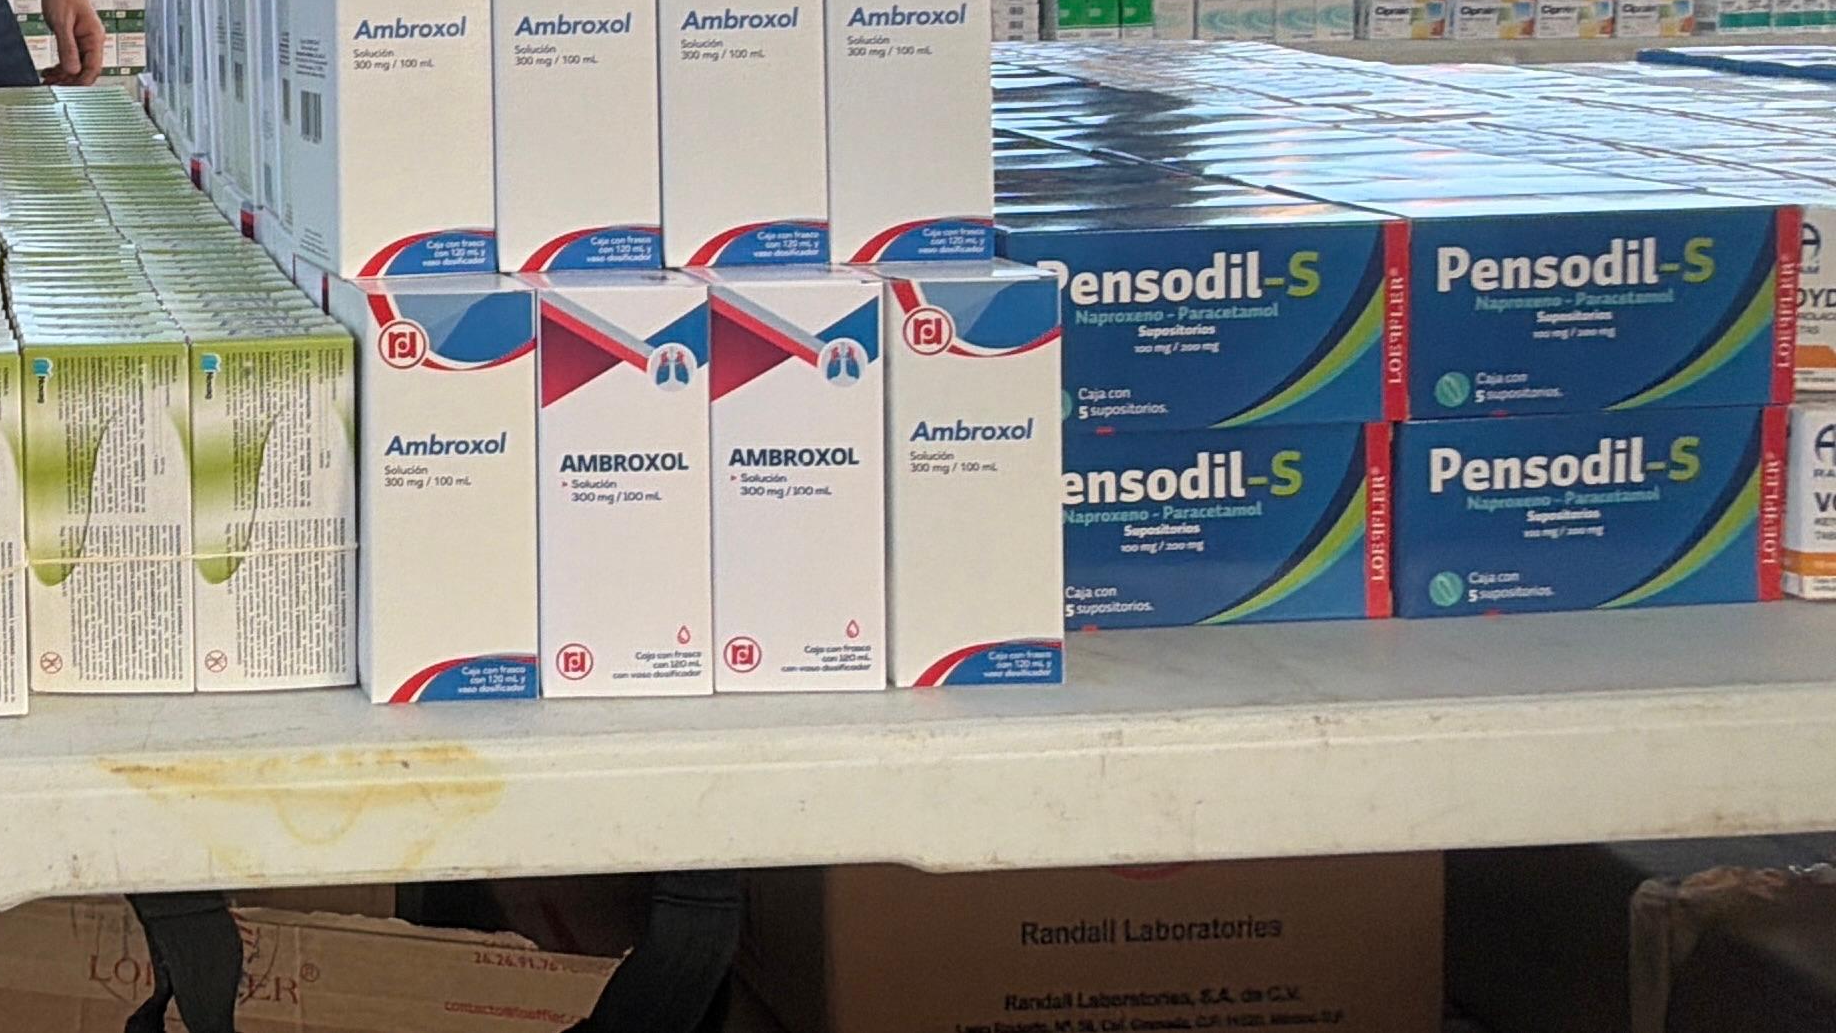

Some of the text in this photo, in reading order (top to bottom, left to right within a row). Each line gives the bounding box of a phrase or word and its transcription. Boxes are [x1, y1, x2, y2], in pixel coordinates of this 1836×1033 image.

[680, 6, 799, 31] Ambroxol
[847, 3, 967, 28] Ambroxol
[353, 15, 466, 40] Ambroxol
[514, 12, 631, 37] Ambroxol
[680, 38, 723, 49] Solución
[847, 35, 890, 45] Solución
[353, 48, 394, 58] Solución
[514, 44, 557, 55] Solución
[1436, 236, 1715, 293] Pensodil-S
[1475, 288, 1675, 313] Naproxeno Paracetamol
[1075, 302, 1278, 328] Naproxeno Paracetamol
[1536, 308, 1613, 325] Supositorios
[1138, 323, 1216, 340] Supositorios
[1475, 372, 1528, 387] Caja con
[1078, 387, 1131, 403] Caja con
[1475, 389, 1485, 404] 5
[1078, 405, 1089, 420] 5
[909, 417, 1034, 442] Ambroxol
[384, 431, 507, 456] Ambroxol
[559, 452, 690, 473] AMBROXOL
[728, 447, 861, 467] AMBROXOL
[909, 450, 955, 460] Solución
[384, 465, 428, 475] Solución
[1429, 436, 1701, 494] Pensodil-S
[384, 477, 404, 487] 300
[406, 478, 423, 489] mg
[571, 479, 617, 488] Solución
[740, 473, 787, 483] Solución
[1061, 450, 1304, 506] ensodil-S
[571, 492, 595, 502] 300
[597, 493, 615, 505] mg
[740, 486, 765, 496] 300
[766, 487, 784, 499] mg
[1466, 486, 1661, 513] Naproxeno Paracetamol
[1063, 501, 1263, 527] Naproxeno Paracetamol
[1526, 508, 1601, 524] Supositorios
[1123, 521, 1201, 539] Supositorios
[1065, 586, 1117, 601] Caja con
[1064, 603, 1075, 618] 5
[1022, 915, 1283, 946] Randall Laboratories
